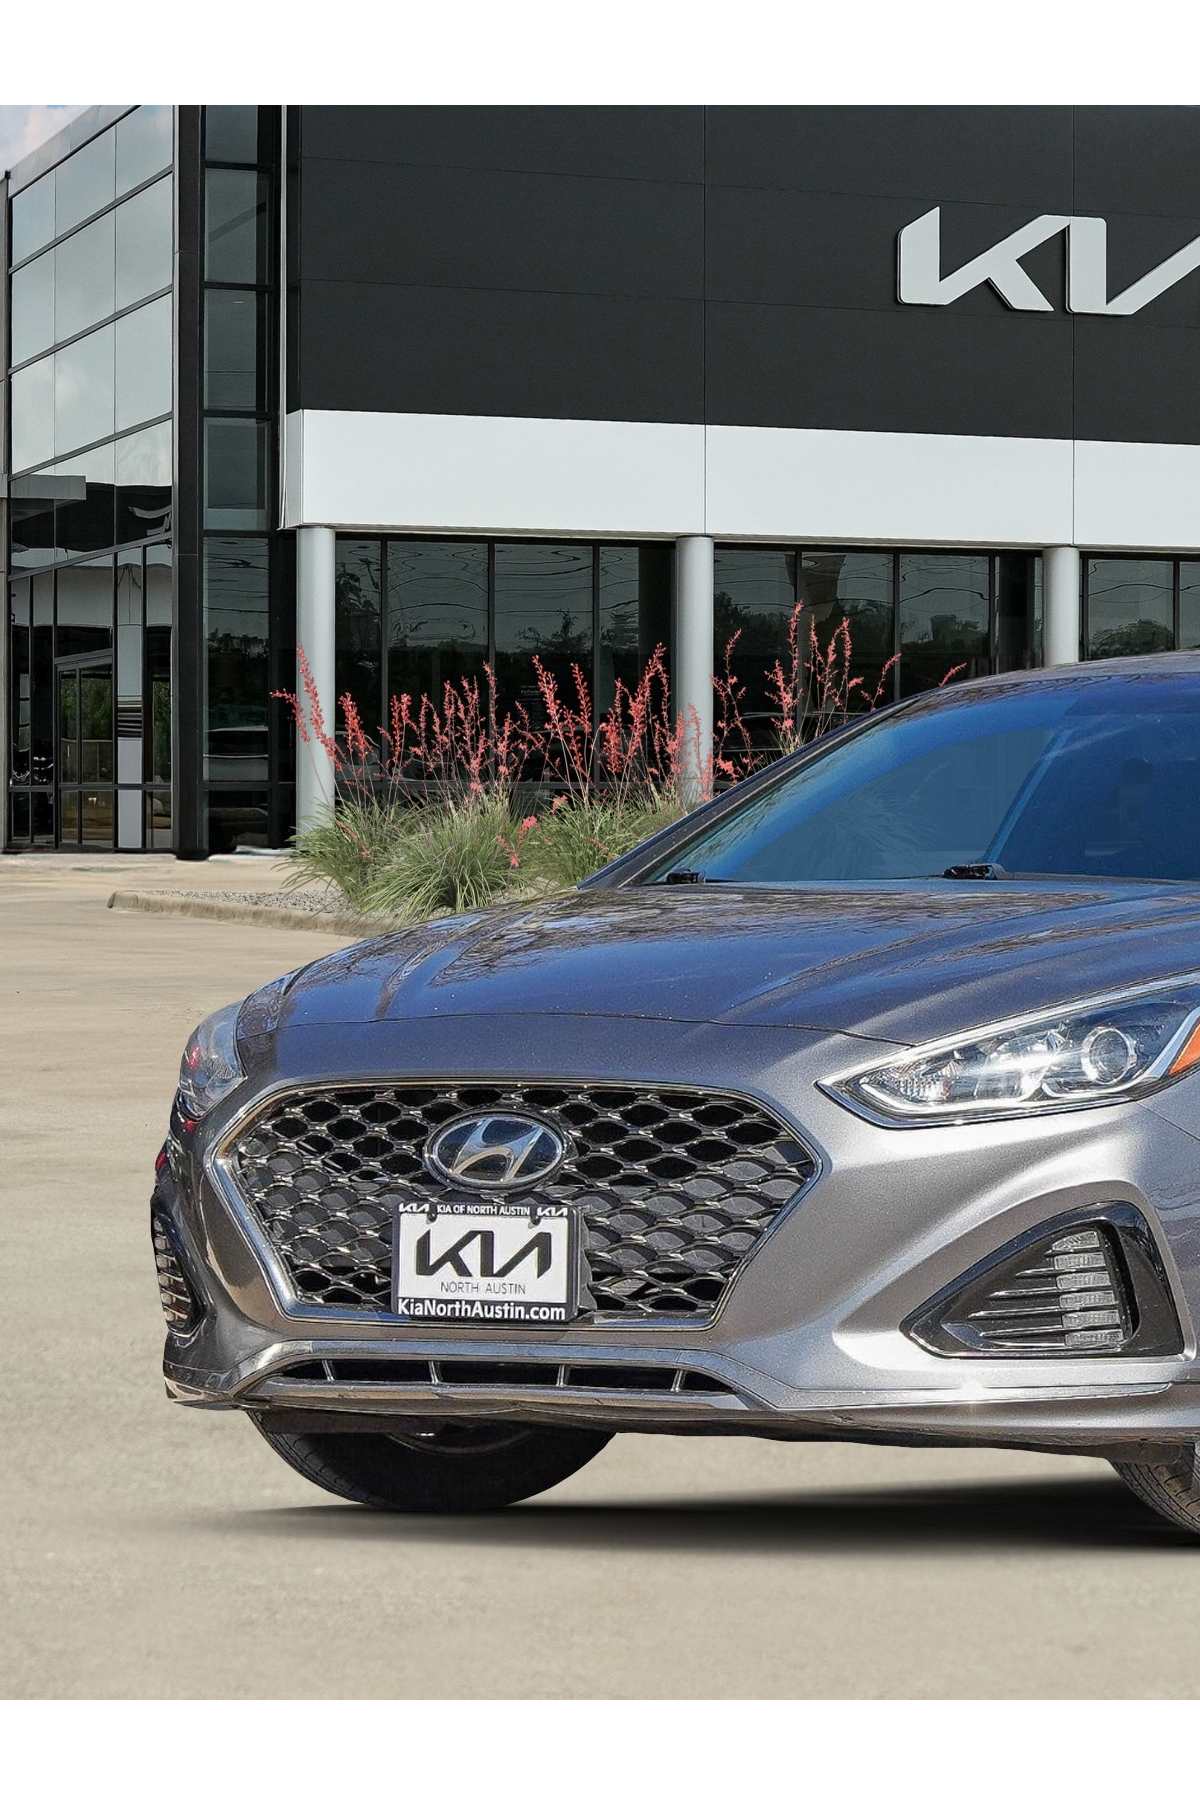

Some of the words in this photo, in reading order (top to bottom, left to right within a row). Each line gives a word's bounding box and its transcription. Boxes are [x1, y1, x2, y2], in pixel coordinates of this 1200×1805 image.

[398, 1203, 430, 1212] KIA
[436, 1204, 452, 1213] KIA
[453, 1204, 465, 1214] OF
[466, 1205, 498, 1215] NORTH
[499, 1205, 530, 1215] AUSTIN
[537, 1207, 568, 1216] KIA
[415, 1228, 552, 1279] KIA
[440, 1281, 479, 1293] NORTH
[485, 1283, 526, 1295] AUSTIN
[398, 1299, 566, 1320] KiaNorthAustin.com
